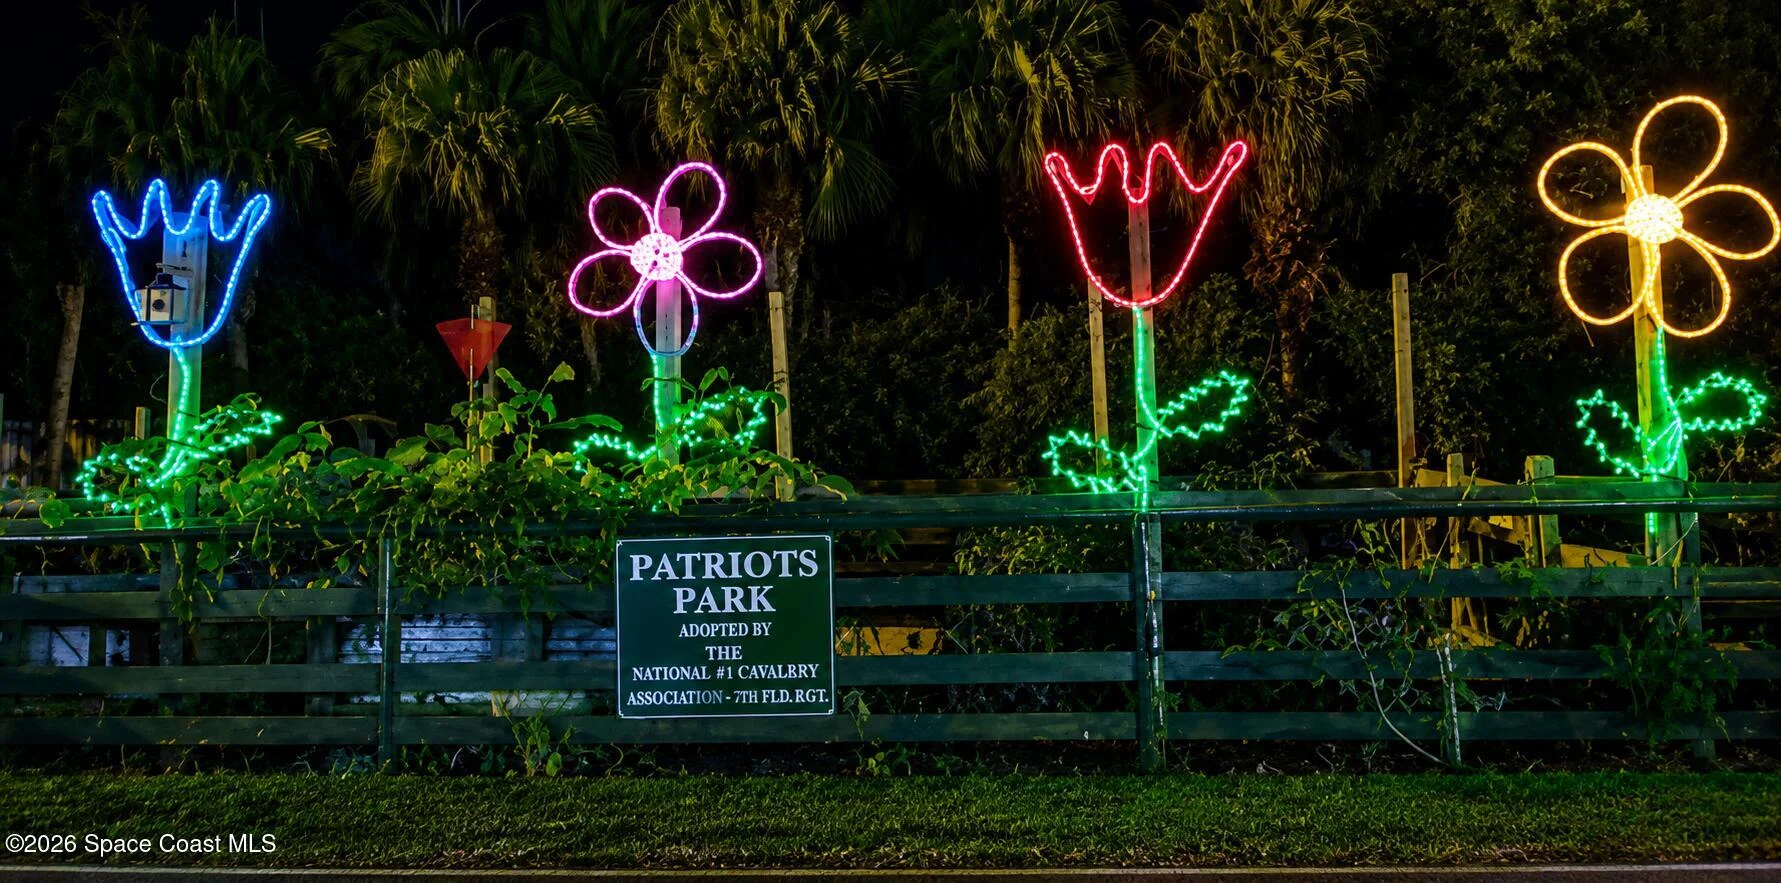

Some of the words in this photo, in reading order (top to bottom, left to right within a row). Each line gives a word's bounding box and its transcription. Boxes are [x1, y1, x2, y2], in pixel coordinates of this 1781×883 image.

[629, 549, 819, 581] PATRIOTS
[672, 585, 777, 614] PARK
[678, 622, 749, 637] ADOPTED
[752, 621, 772, 636] BY
[705, 645, 743, 661] THE
[632, 665, 711, 681] NATIONAL
[716, 665, 733, 680] #1
[626, 690, 723, 706] ASSOCIATION
[733, 690, 759, 704] 7TH
